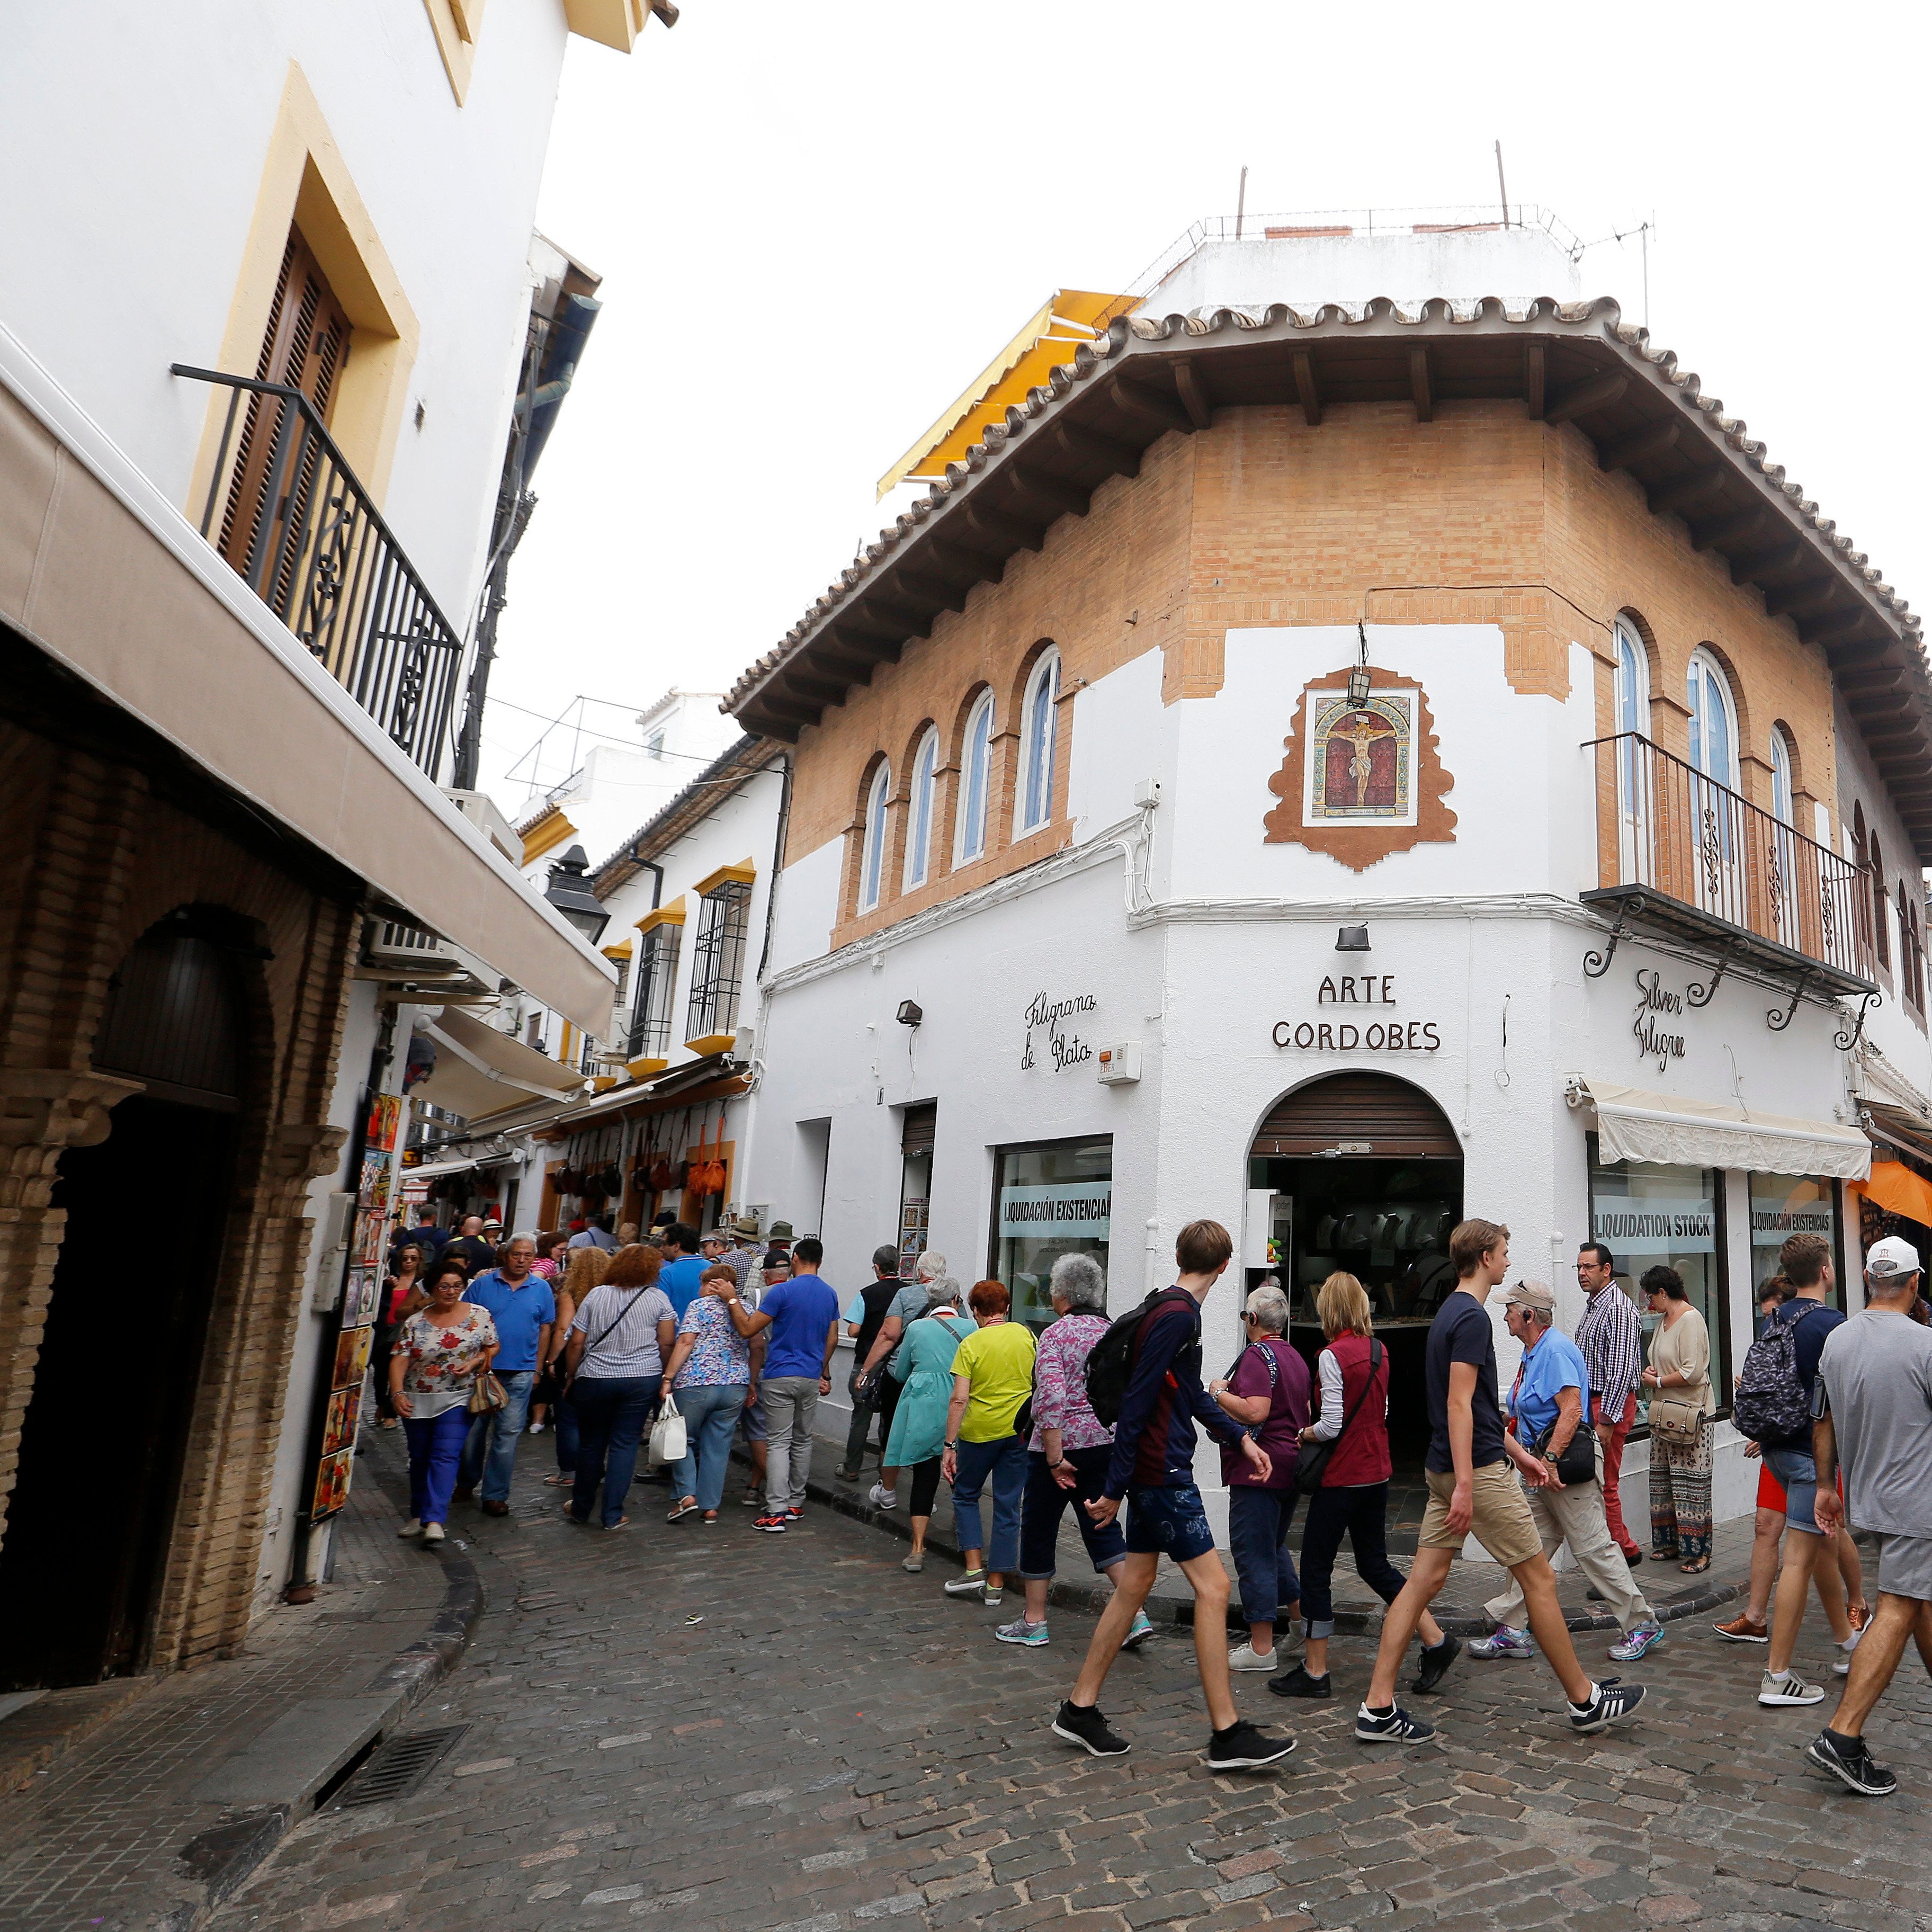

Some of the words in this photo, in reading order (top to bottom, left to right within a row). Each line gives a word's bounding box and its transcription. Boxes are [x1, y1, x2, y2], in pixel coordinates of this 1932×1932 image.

[1318, 976, 1396, 1004] ARTE
[1634, 969, 1683, 1015] Silver
[1025, 990, 1097, 1041] Filigrana
[1272, 1021, 1441, 1051] CORDOBES
[1634, 1007, 1685, 1072] Filigree
[1021, 1031, 1036, 1070] de
[1051, 1033, 1093, 1073] Plata
[1100, 1062, 1115, 1074] EBER
[1004, 1196, 1054, 1223] LIQUIDACIÓN
[1056, 1198, 1110, 1221] EXISTENCIA
[1751, 1209, 1791, 1231] LIQUIDACIÓN
[1792, 1214, 1830, 1231] EXISTENCIAS
[1594, 1213, 1671, 1240] LIQUIDATION
[1674, 1214, 1710, 1237] STOCK
